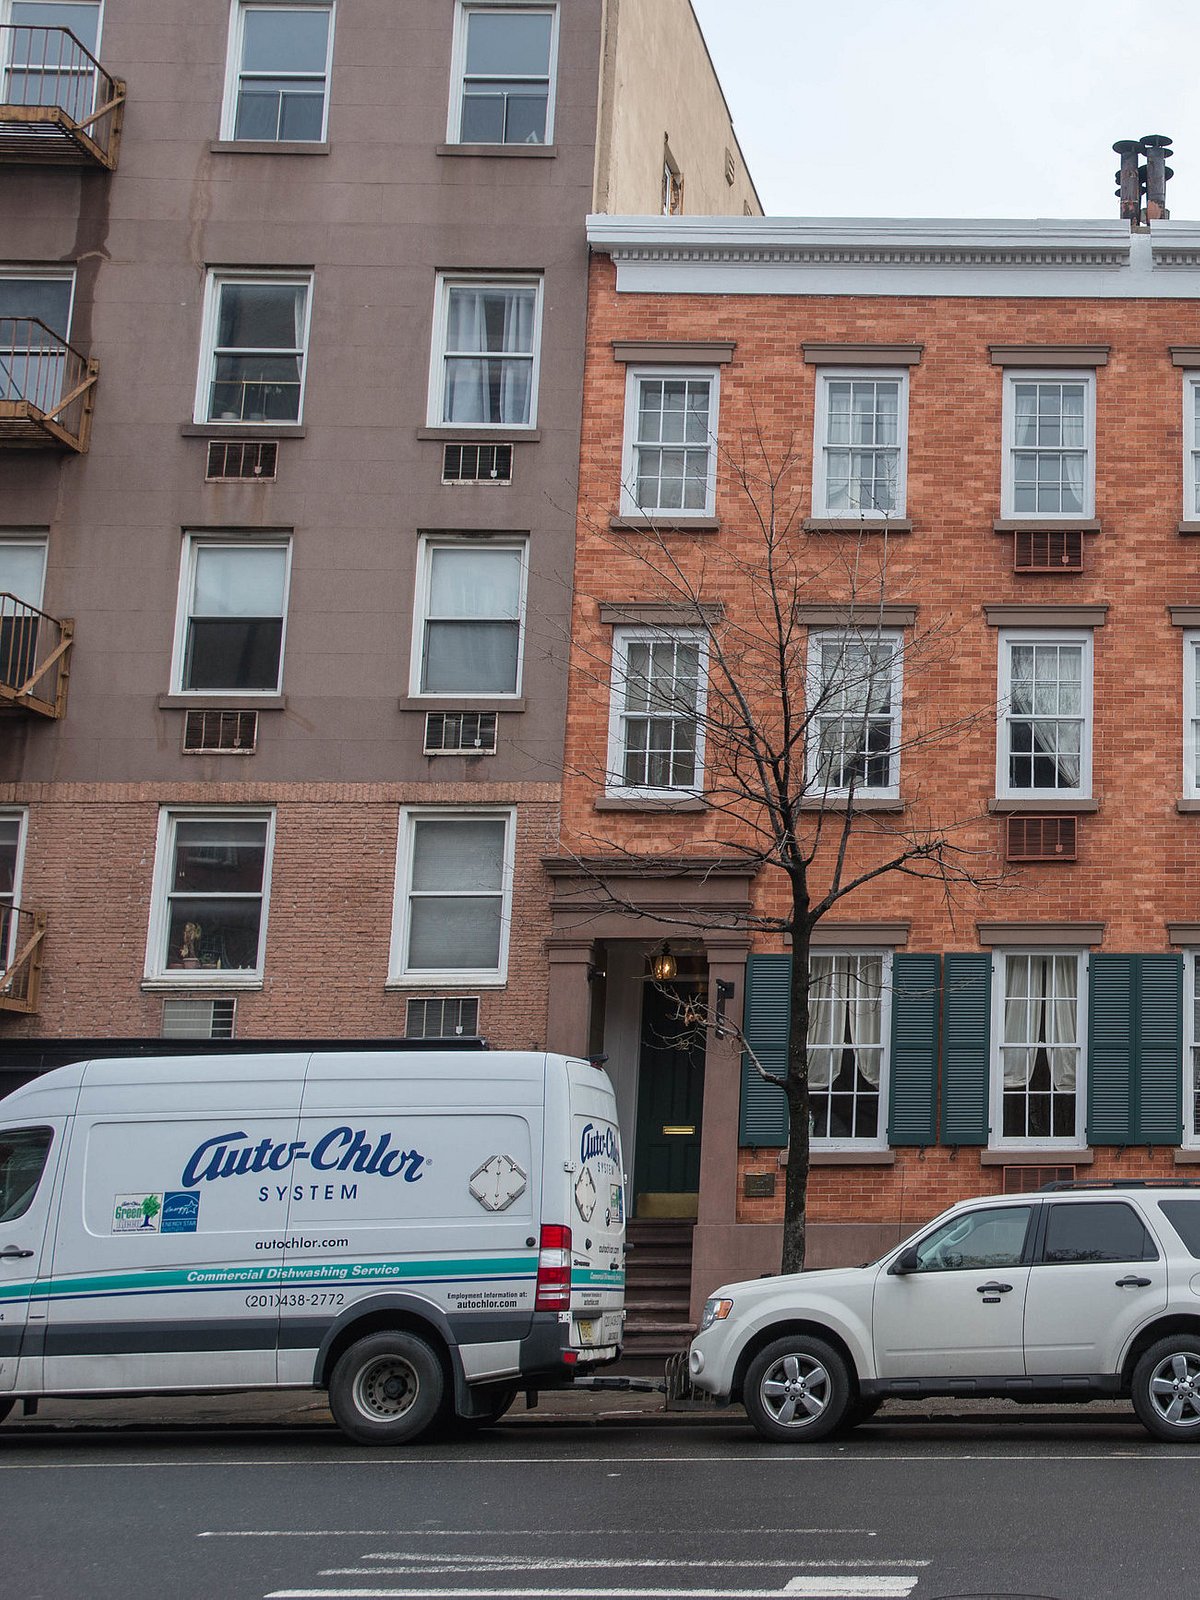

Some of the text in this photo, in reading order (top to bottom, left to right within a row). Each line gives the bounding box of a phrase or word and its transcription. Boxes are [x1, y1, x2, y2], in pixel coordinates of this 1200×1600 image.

[258, 1184, 359, 1202] SYSTEM
[115, 1206, 142, 1219] Green
[255, 1237, 349, 1250] autochlor.com
[187, 1264, 400, 1282] Commercial Dishwashing Service
[245, 1293, 345, 1308] (201)438-2772
[447, 1292, 483, 1300] Employment
[484, 1291, 518, 1299] Information
[457, 1299, 517, 1309] autochlor.com
